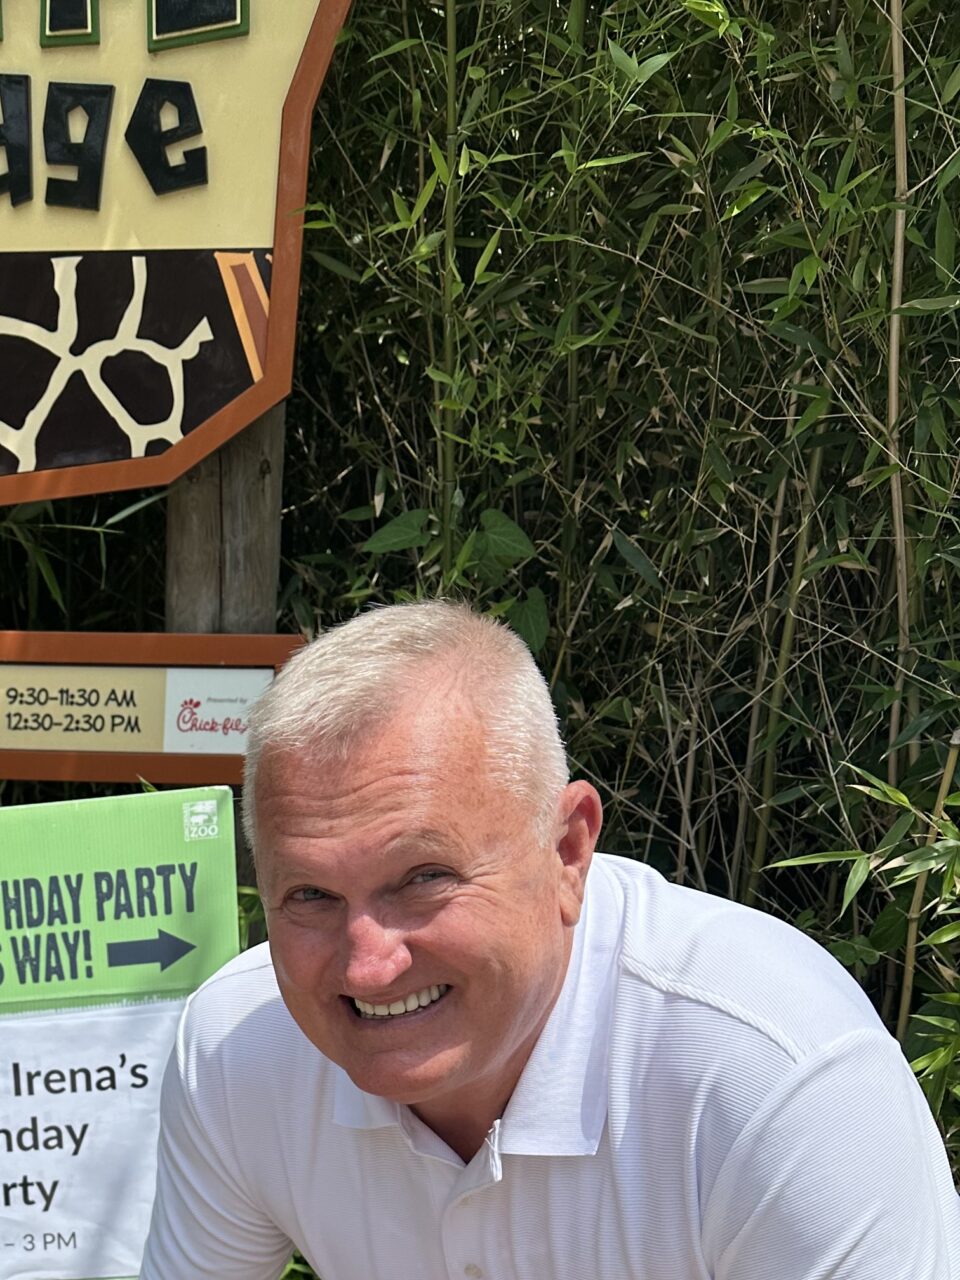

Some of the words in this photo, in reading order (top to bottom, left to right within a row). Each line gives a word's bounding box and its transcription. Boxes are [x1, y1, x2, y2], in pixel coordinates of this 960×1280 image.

[5, 687, 101, 708] 9:30-11:30
[104, 688, 137, 708] AM
[6, 712, 106, 732] 12:30-2:30
[110, 714, 141, 733] PM
[190, 824, 218, 838] ZOO
[93, 861, 198, 922] PARTY
[10, 929, 94, 985] WAY!
[23, 1233, 36, 1252] 3
[43, 1231, 78, 1250] PM
